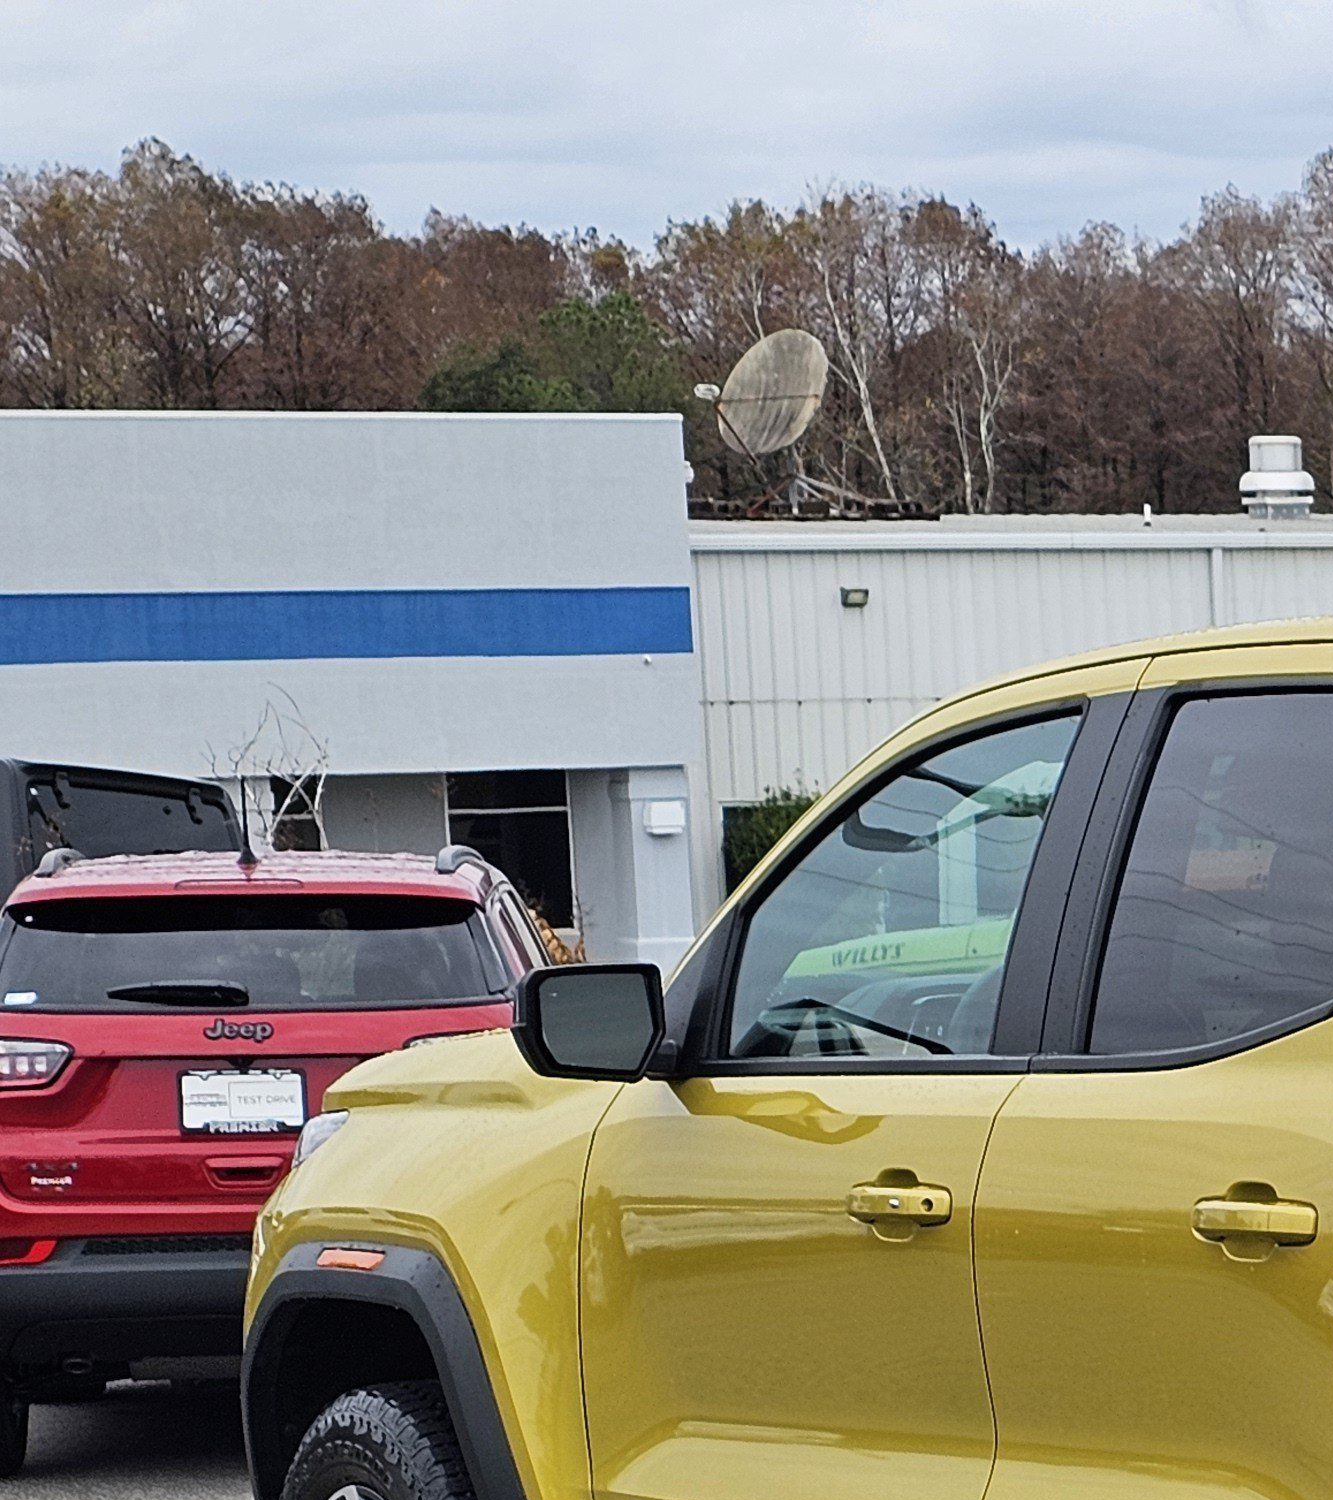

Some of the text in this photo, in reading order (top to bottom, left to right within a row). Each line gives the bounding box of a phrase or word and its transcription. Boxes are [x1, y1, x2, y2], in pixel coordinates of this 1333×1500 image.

[832, 943, 905, 967] WILLYS
[203, 1018, 274, 1043] Jeep
[237, 1095, 263, 1105] TEST
[266, 1094, 297, 1104] DRIVE
